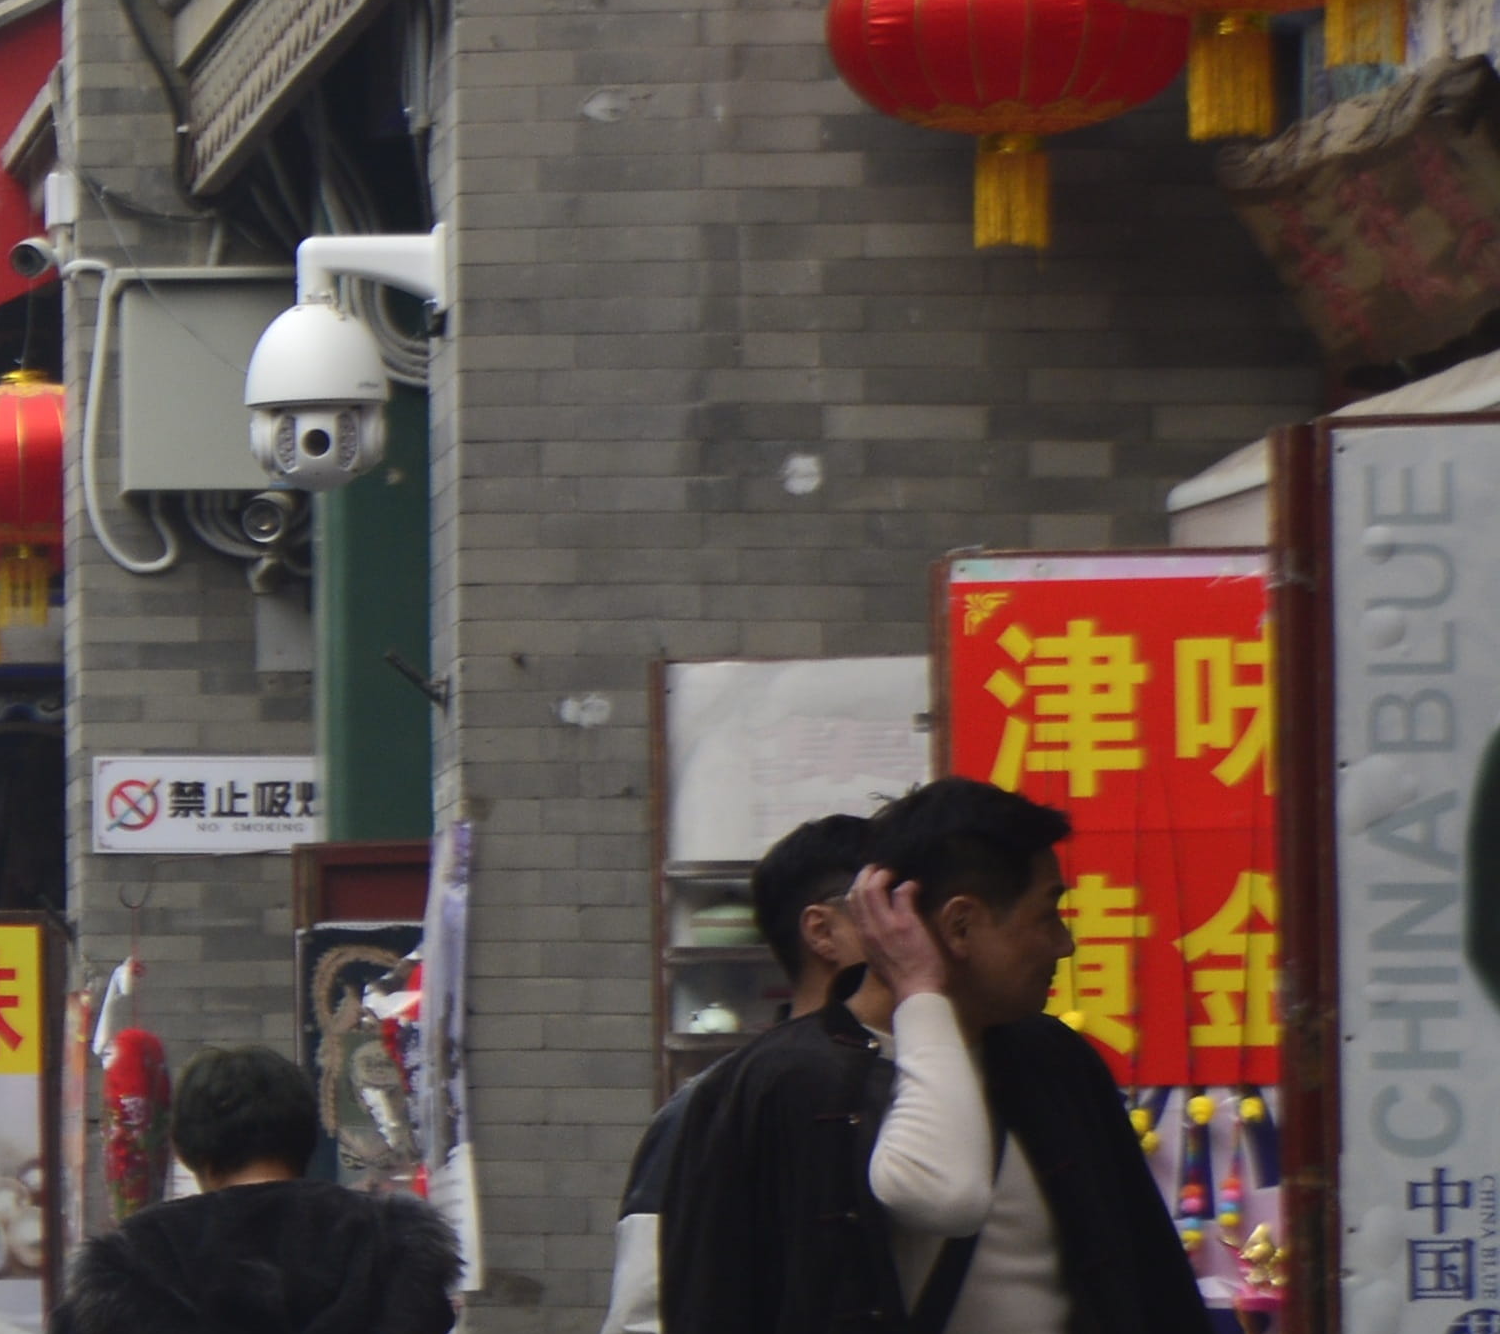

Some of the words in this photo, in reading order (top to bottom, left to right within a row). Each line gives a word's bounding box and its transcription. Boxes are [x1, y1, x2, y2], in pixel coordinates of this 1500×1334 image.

[1364, 459, 1458, 754] BLUE
[197, 822, 220, 833] NO
[232, 822, 305, 834] SMOKING
[1369, 789, 1464, 1157] CHINA
[1480, 1175, 1497, 1239] CHINA
[1481, 1247, 1498, 1301] BLUE
